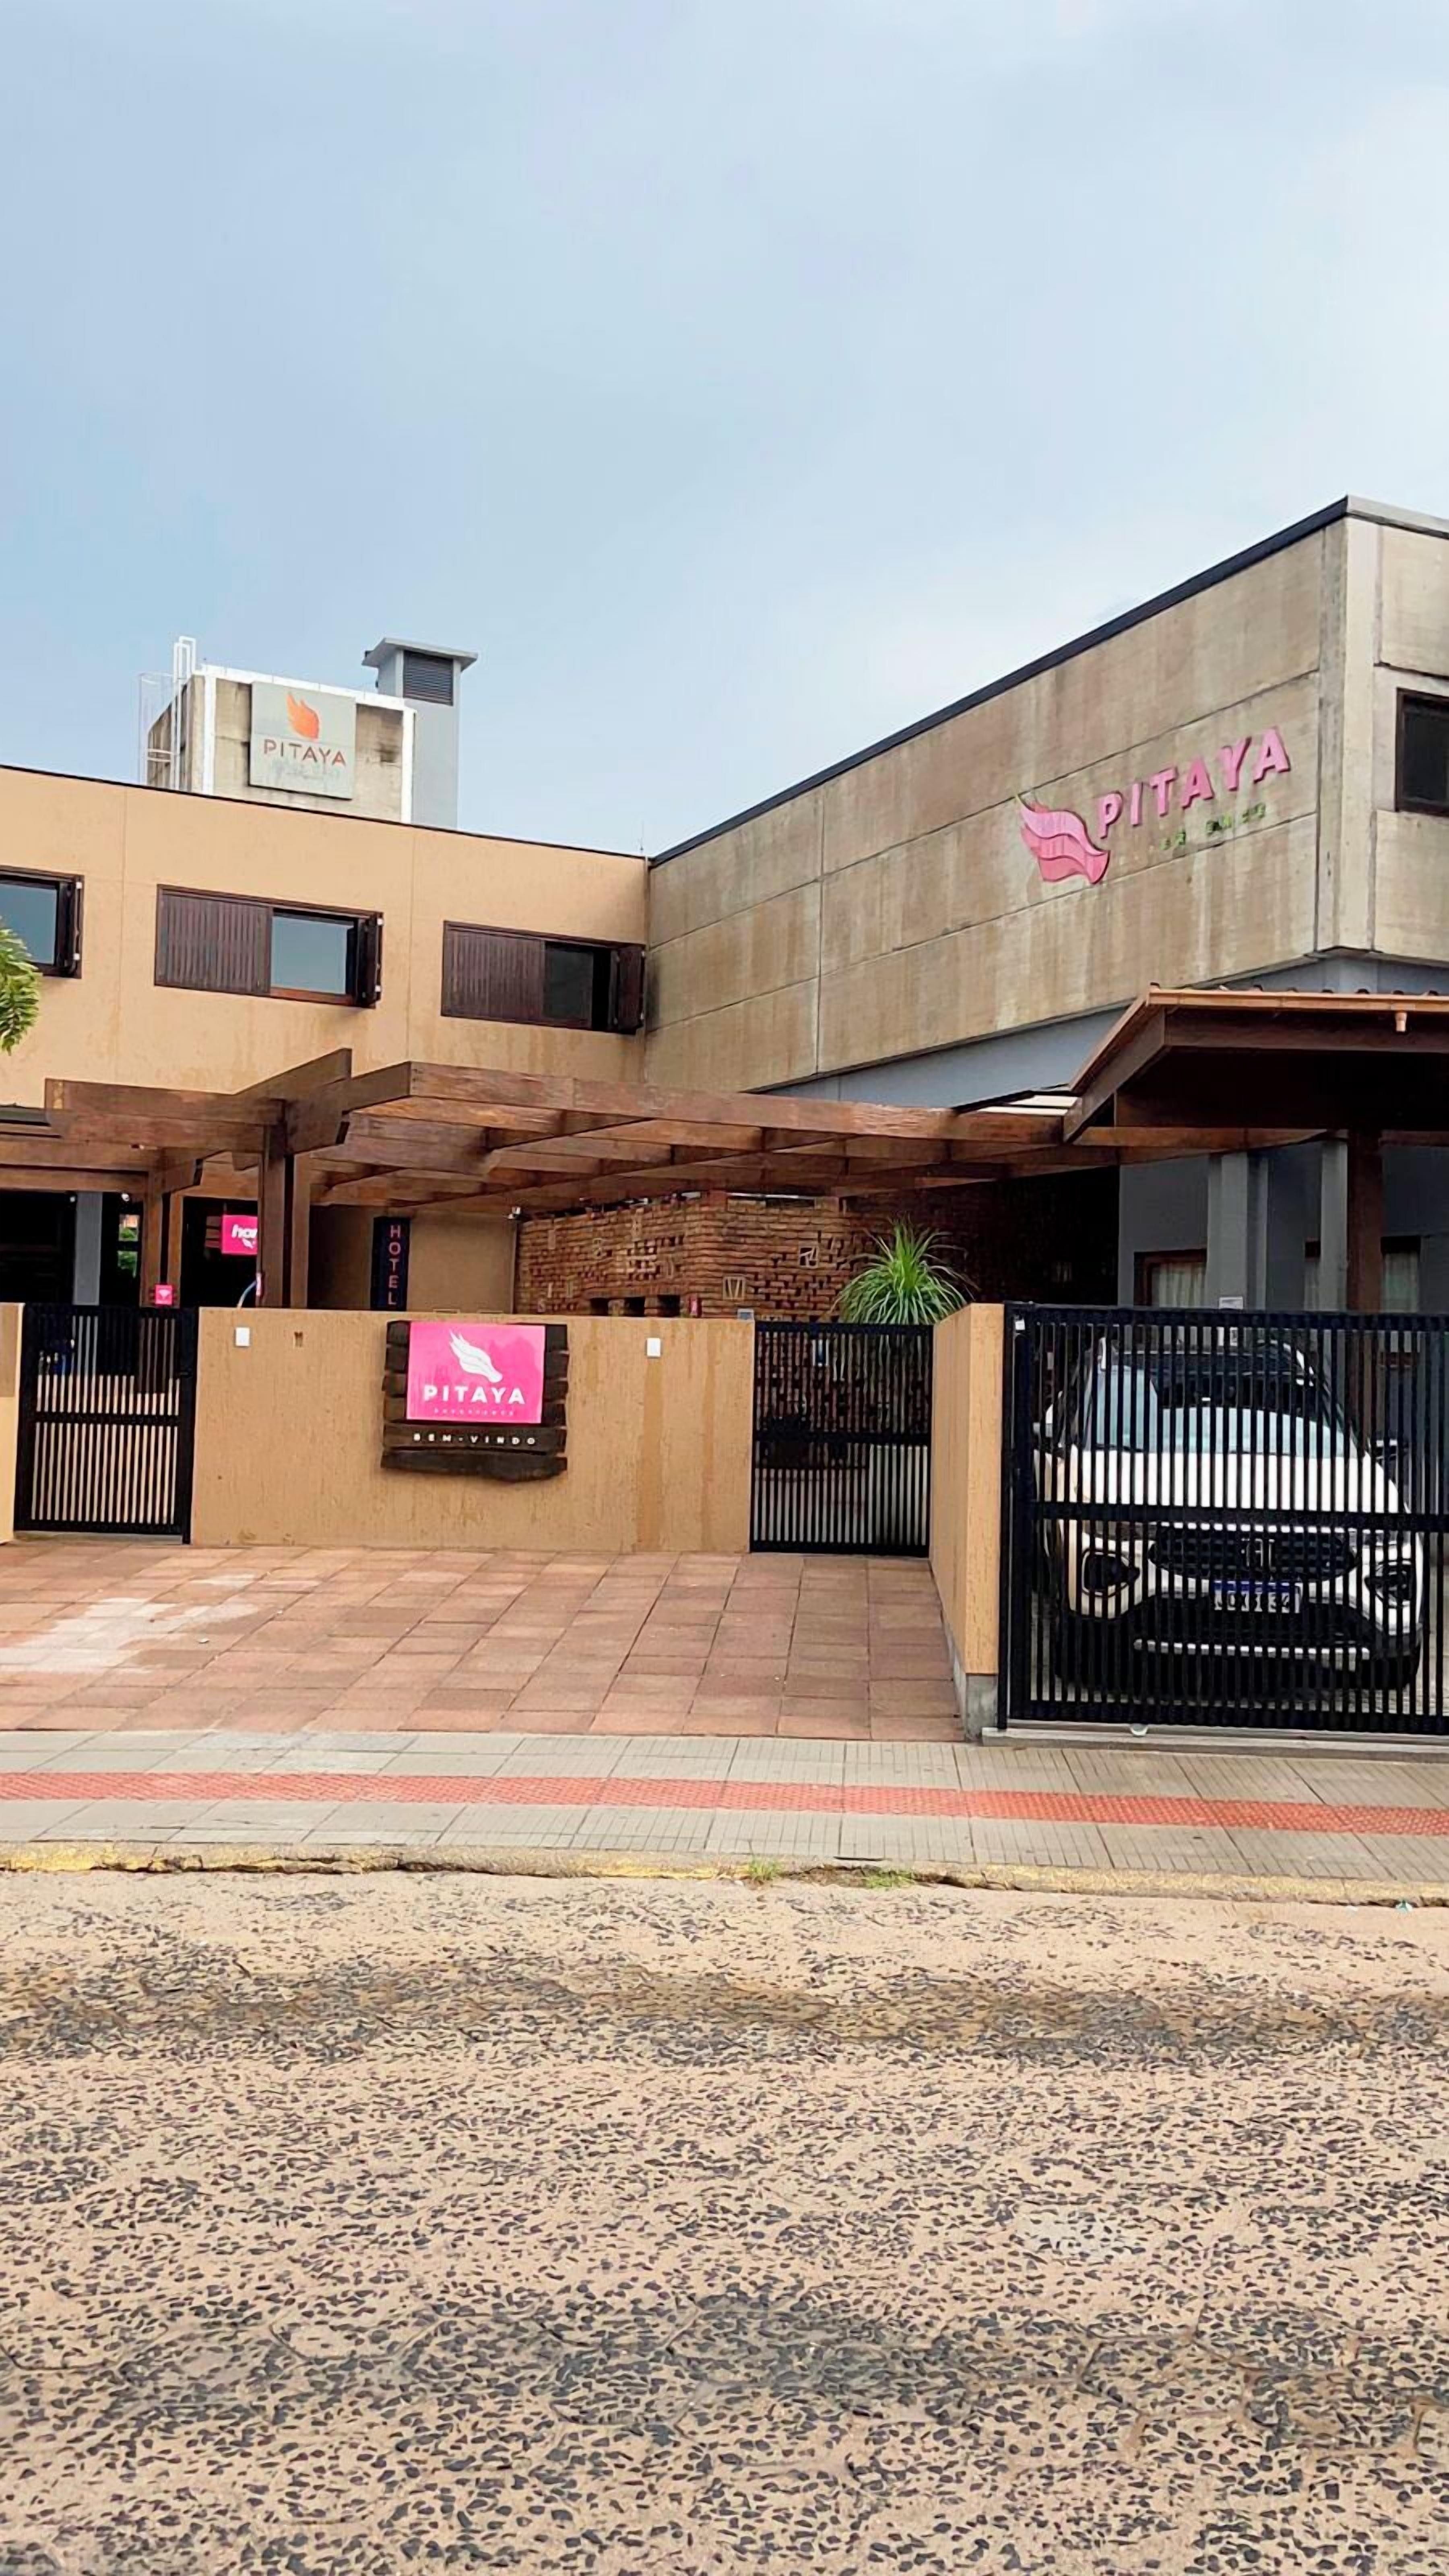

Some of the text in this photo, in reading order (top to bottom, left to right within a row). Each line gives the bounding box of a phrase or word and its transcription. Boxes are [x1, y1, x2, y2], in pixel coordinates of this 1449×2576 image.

[264, 739, 346, 766] PITAYA
[1098, 726, 1291, 839] PITAYA
[388, 1225, 401, 1305] HOTEL
[423, 1385, 525, 1404] PITAYA
